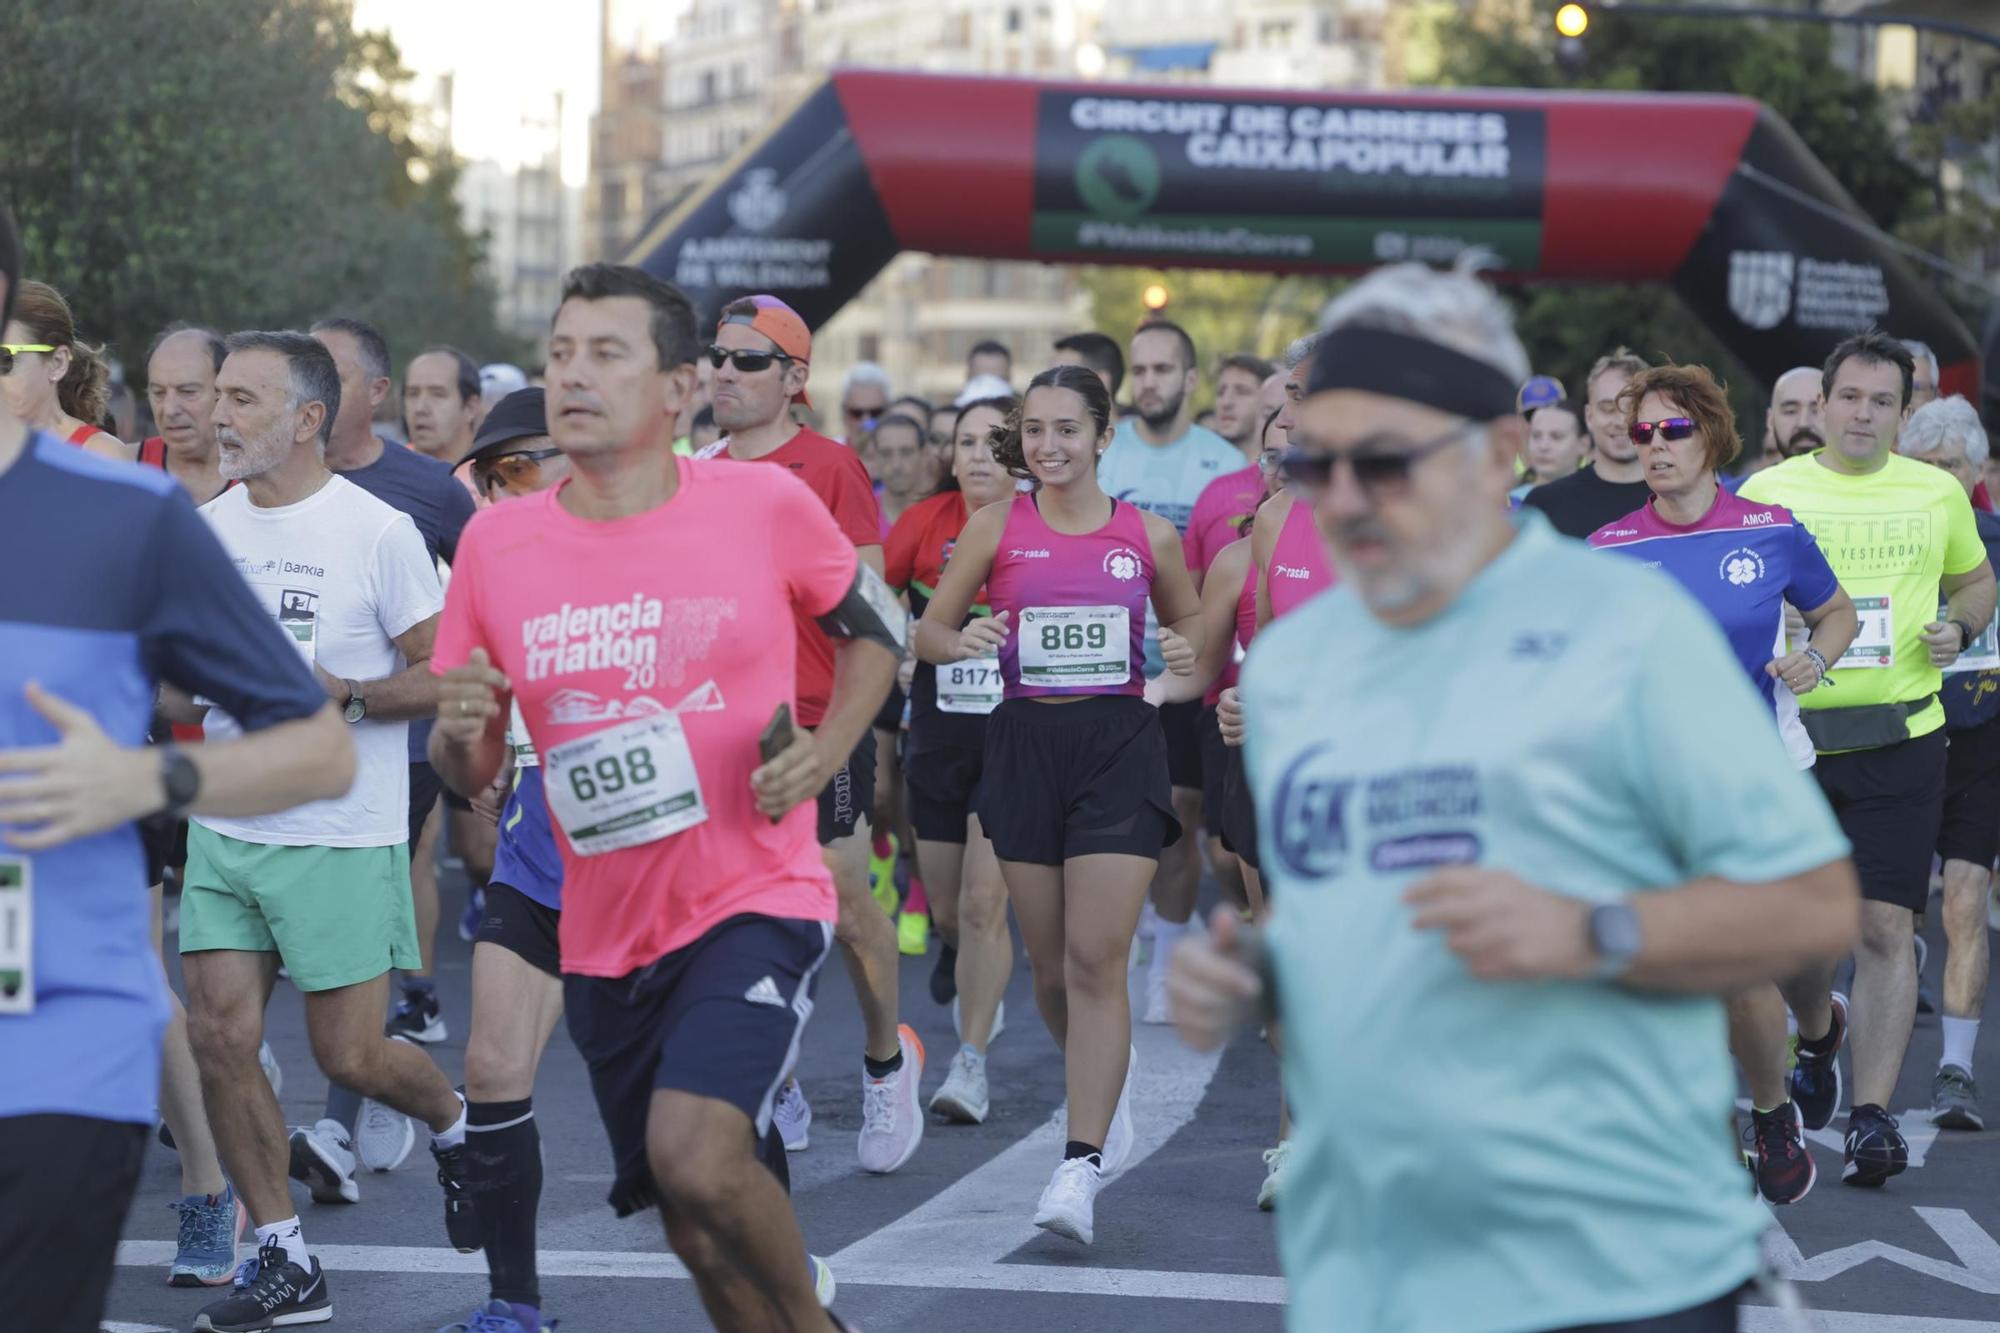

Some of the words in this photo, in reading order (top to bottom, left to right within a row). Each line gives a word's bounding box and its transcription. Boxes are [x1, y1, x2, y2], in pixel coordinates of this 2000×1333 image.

[1070, 98, 1226, 134] CIRCUIT
[1231, 104, 1287, 137] DE
[1290, 107, 1507, 144] CARRERES
[1742, 511, 1774, 526] AMOR
[1806, 517, 1926, 544] ETTER
[1841, 543, 1923, 561] YESTERDAY
[284, 561, 325, 577] Bankia
[1286, 566, 1310, 580] rasán
[522, 592, 662, 647] valencia
[1041, 623, 1106, 650] 869
[526, 629, 657, 682] triatlón
[951, 667, 1000, 686] 8171
[569, 747, 657, 802] 698
